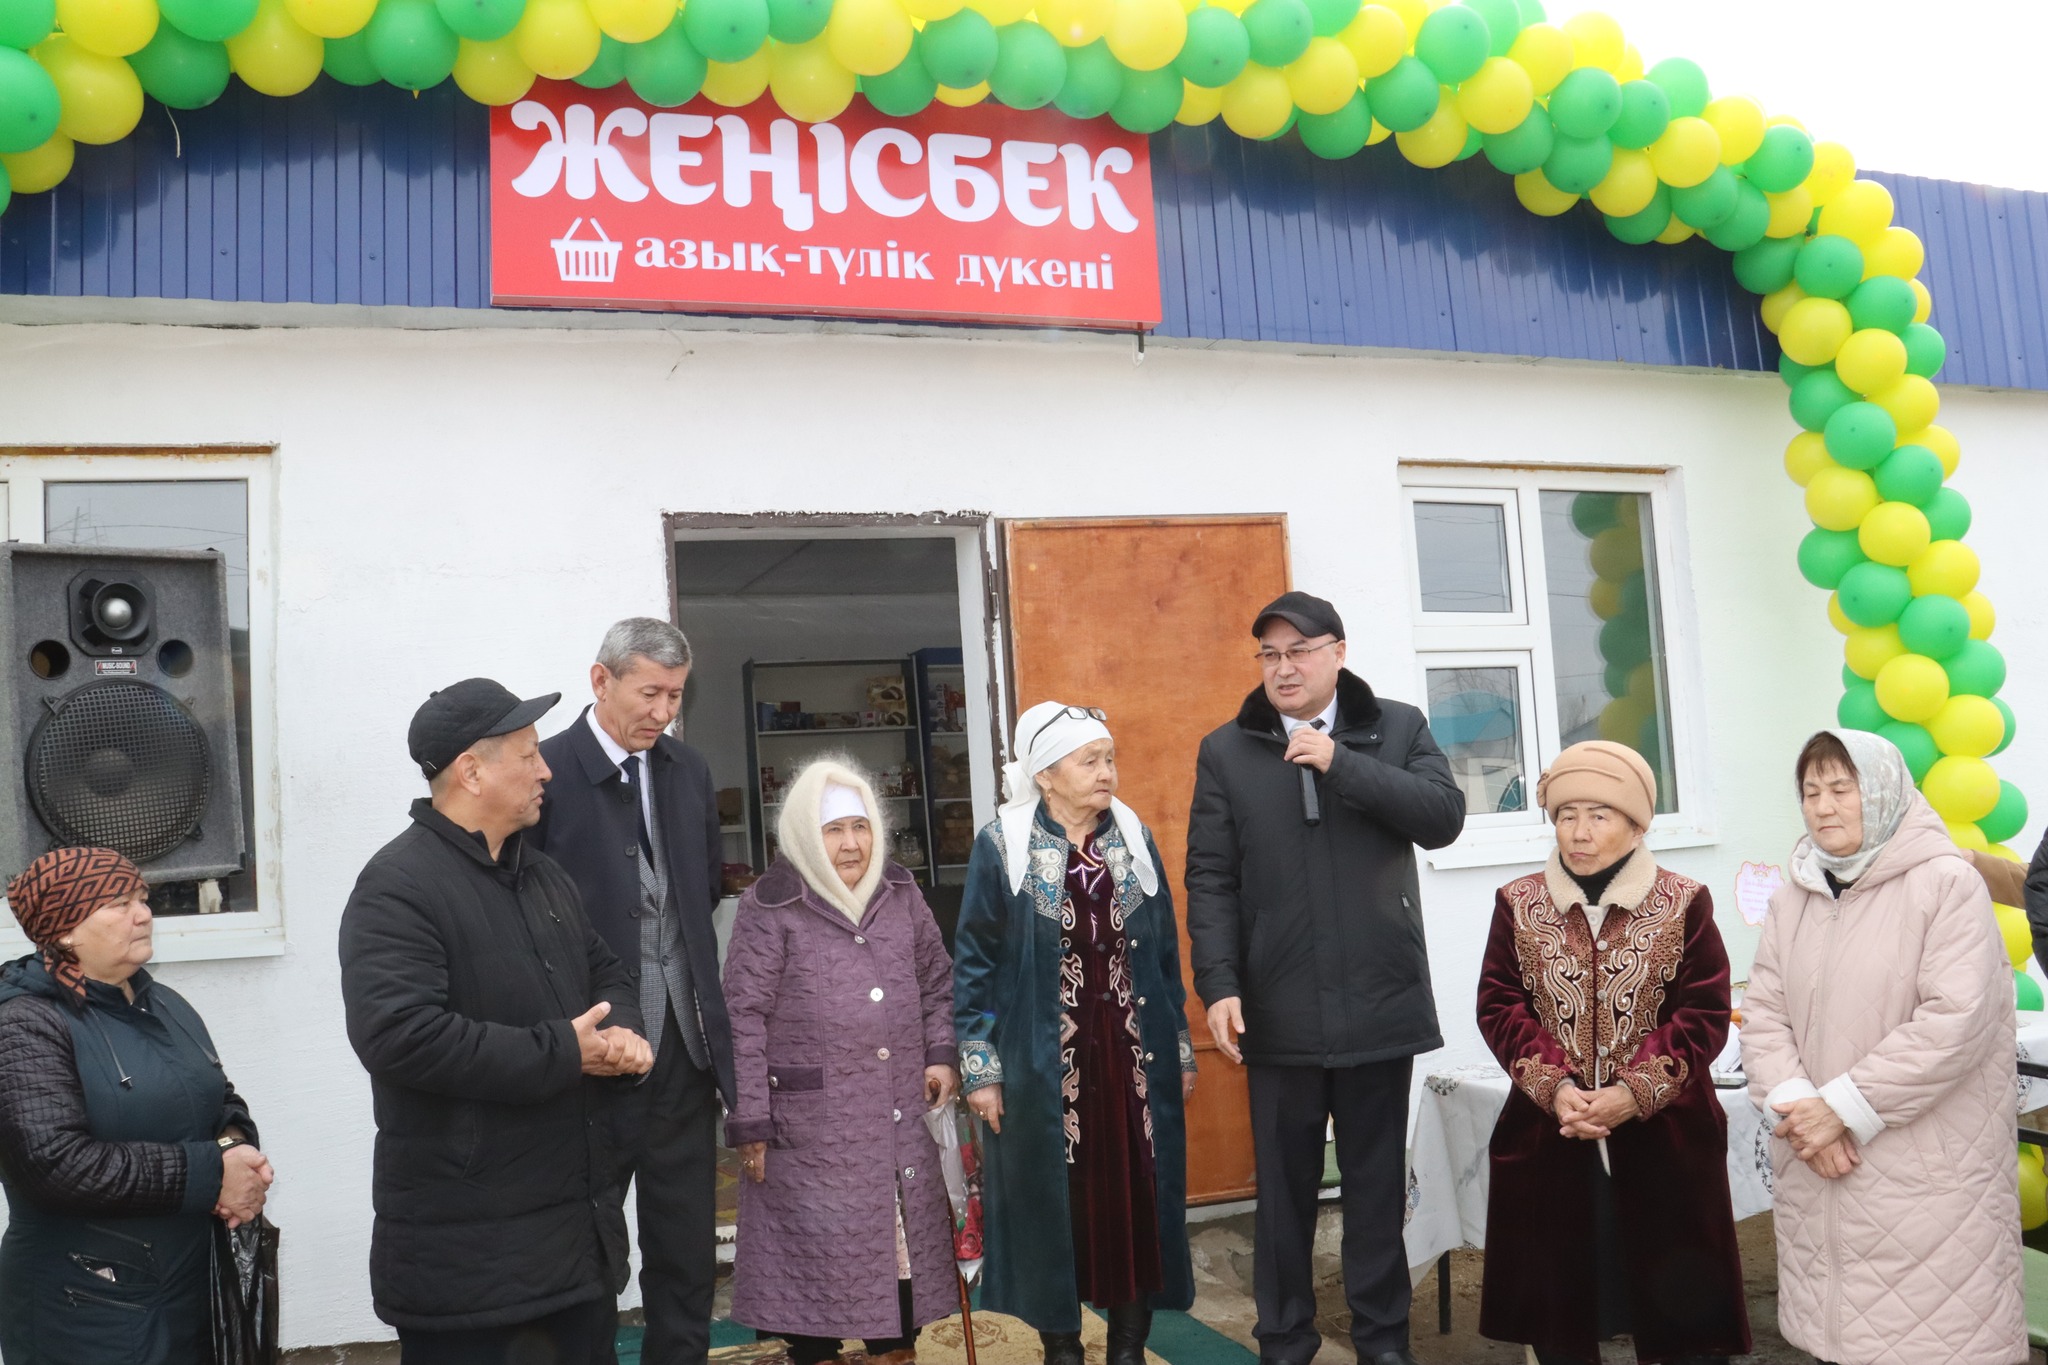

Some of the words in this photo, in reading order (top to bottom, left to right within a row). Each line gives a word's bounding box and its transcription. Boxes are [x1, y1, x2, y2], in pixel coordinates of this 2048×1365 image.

[511, 101, 1139, 233] ЖЕҢІСБЕК
[634, 236, 934, 286] азық-түлік
[956, 253, 1113, 293] дүкені
